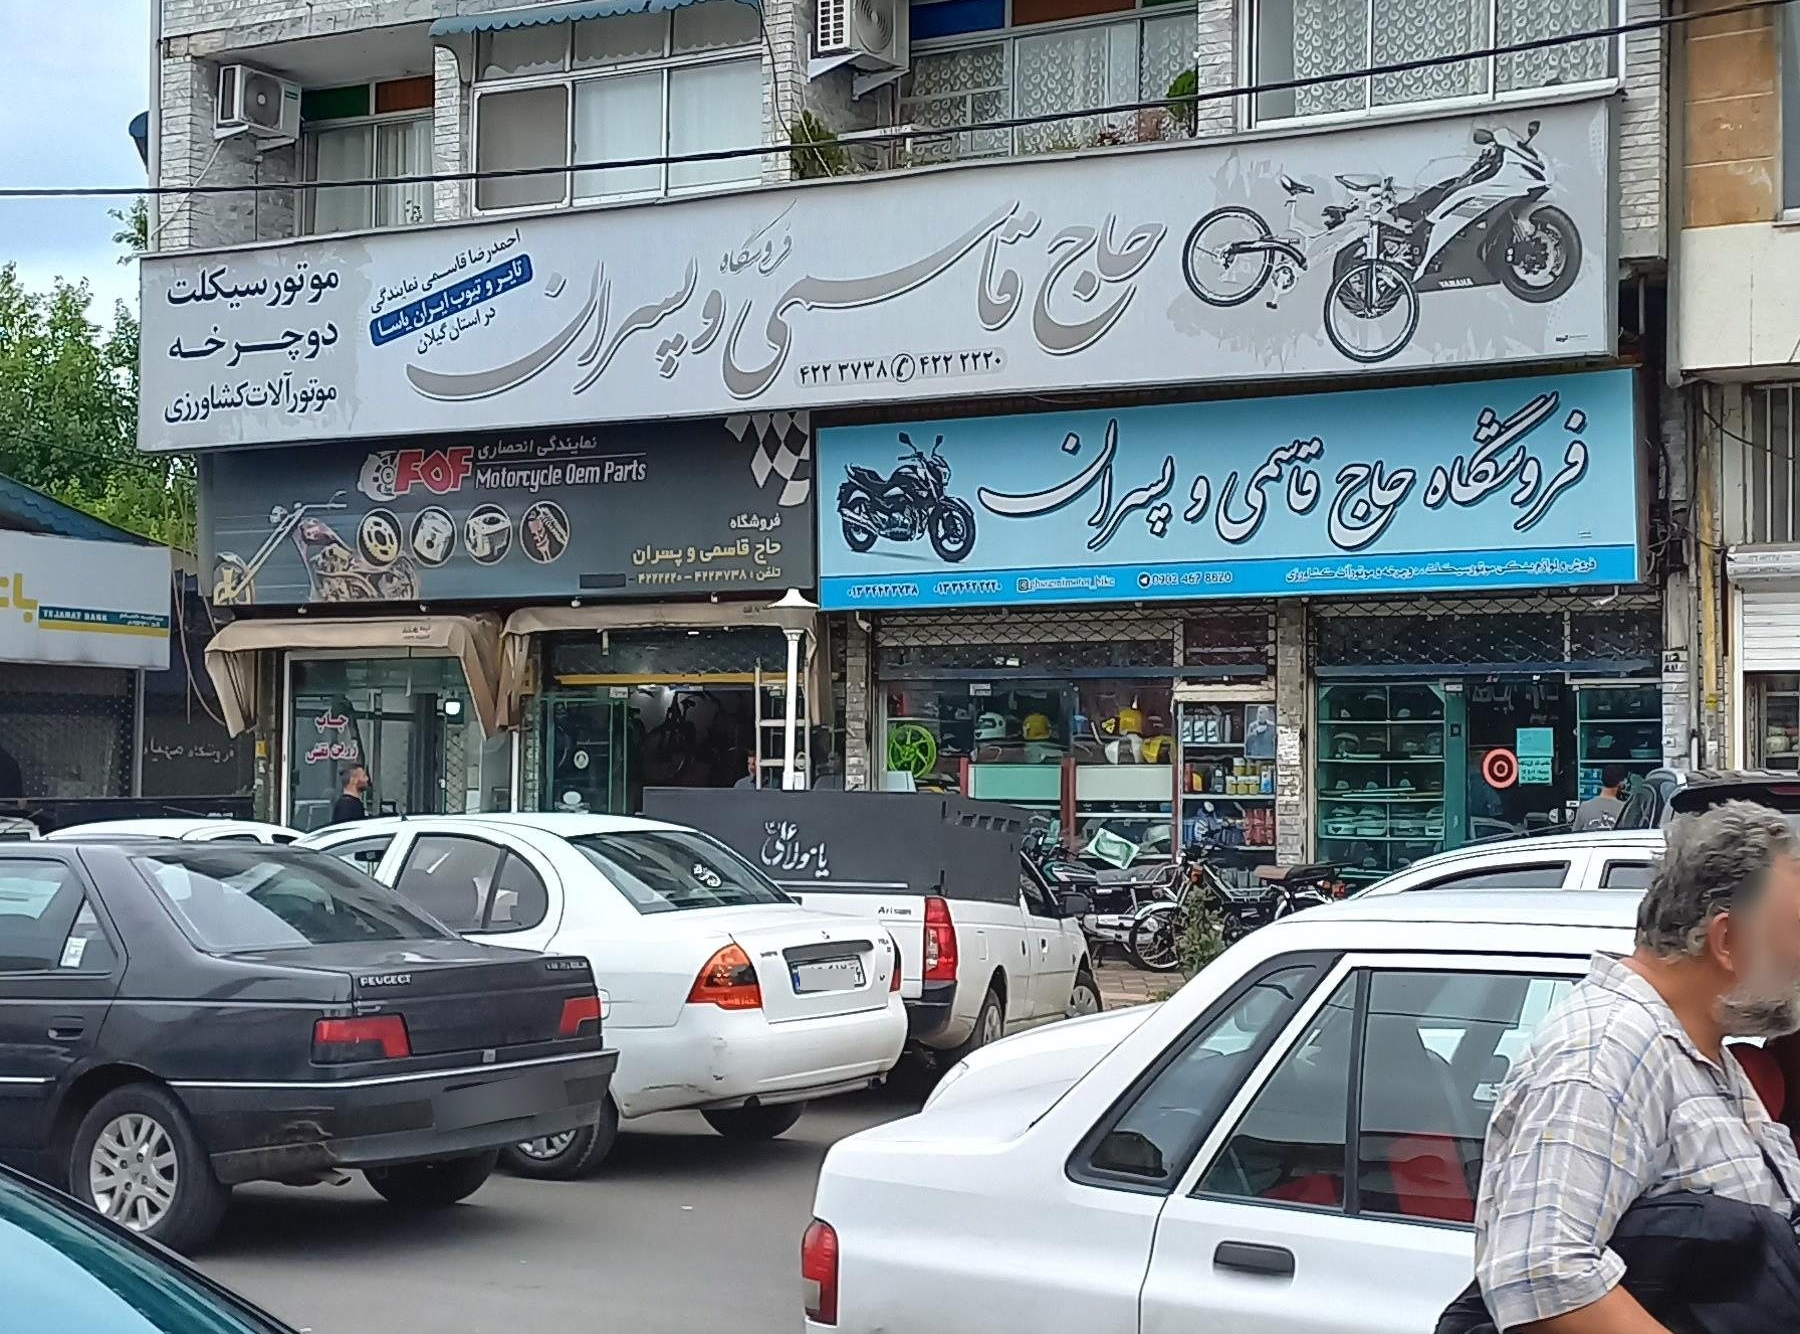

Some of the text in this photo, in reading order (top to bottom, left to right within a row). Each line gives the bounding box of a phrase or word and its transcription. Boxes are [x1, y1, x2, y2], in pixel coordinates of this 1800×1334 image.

[720, 198, 799, 276] فروشگاه
[167, 263, 340, 308] موتورسیکلت
[371, 228, 521, 314] احمدرضا قاسمی نمایندگی
[377, 259, 522, 337] تایر و تیوب ایران یاسا
[406, 199, 1168, 403] حاج قاسمی و پسران
[168, 322, 339, 367] دوچرخه
[416, 306, 496, 355] در استان گیلان
[800, 359, 888, 385] ۴۲۲ ۳۷۳۸
[920, 350, 1002, 375] ۴۲۲ ۲۲۲۰
[164, 381, 249, 423] کشاورزی
[477, 435, 598, 460] نمایندگی انحصاری
[475, 459, 647, 494] Motorcycle Oem Parts
[977, 391, 1589, 552] فروشگاه حاج قاسمی و پسران
[729, 513, 782, 531] فروشگاه
[632, 537, 782, 567] حاج قاسمی و پسران
